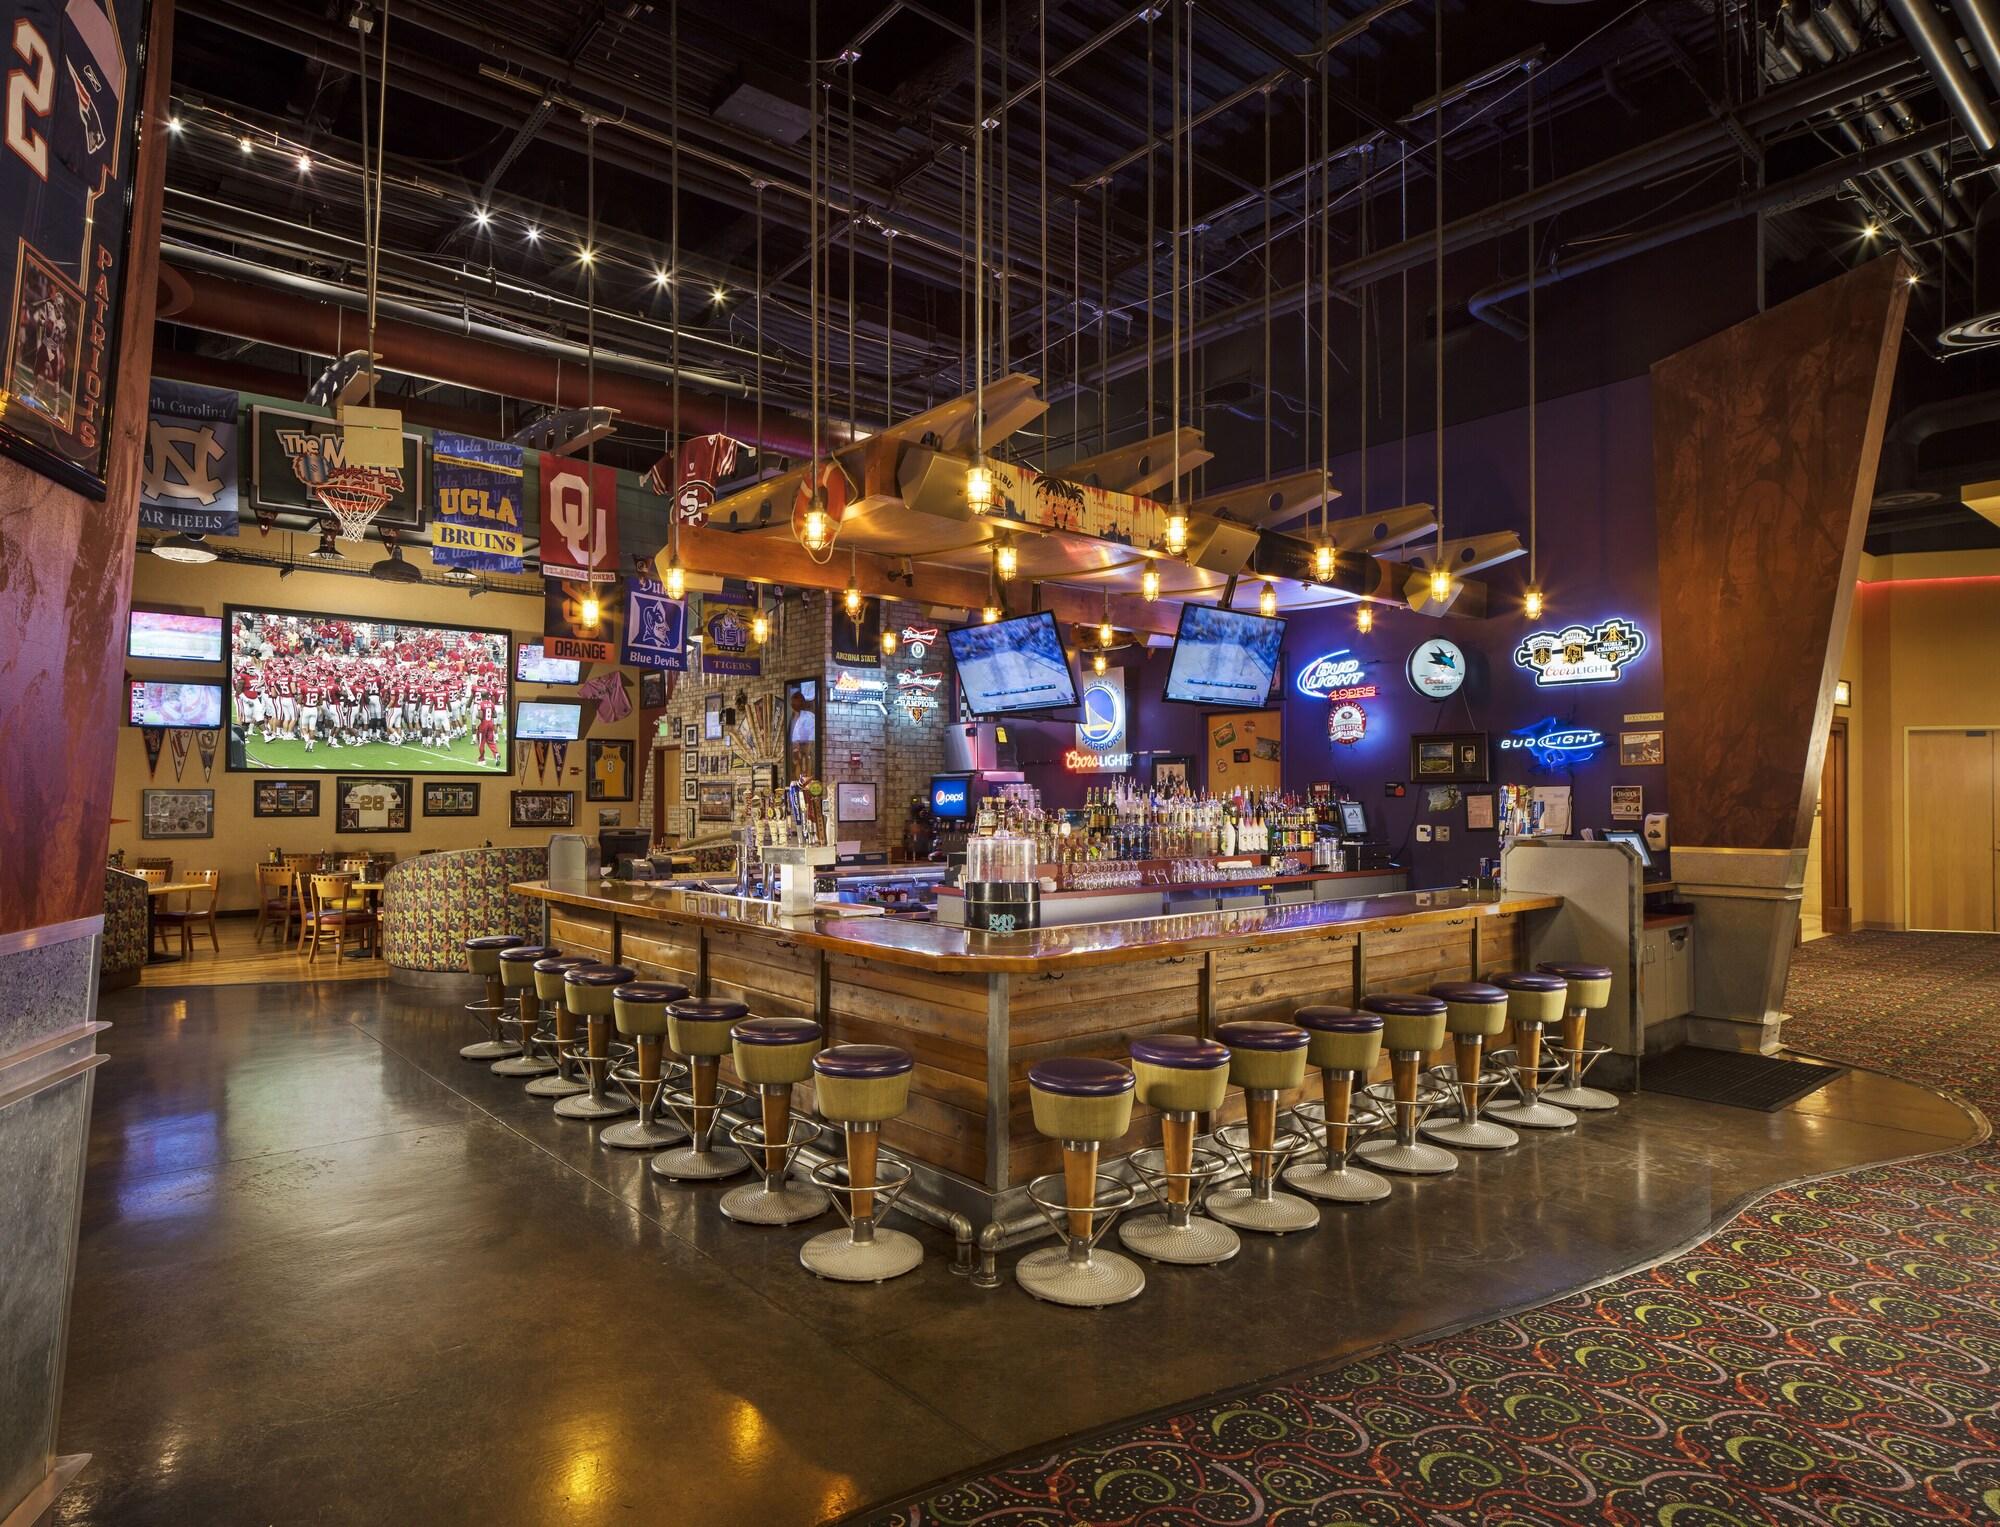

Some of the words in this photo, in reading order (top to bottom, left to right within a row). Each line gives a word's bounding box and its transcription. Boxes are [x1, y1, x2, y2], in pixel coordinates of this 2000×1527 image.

[80, 244, 114, 448] PATRIOTS
[170, 398, 227, 418] Carolina
[283, 434, 319, 455] The
[439, 488, 518, 527] UCLA
[171, 513, 223, 529] HEELS
[440, 527, 516, 552] BRUINS
[554, 640, 607, 659] ORANGE
[835, 651, 860, 662] ARIZONA
[860, 654, 878, 663] STATE
[629, 651, 651, 664] Blue
[654, 654, 680, 668] Devils
[713, 660, 752, 671] TIGERS
[1315, 660, 1359, 677] BUD
[1545, 664, 1576, 677] Coors
[1576, 664, 1609, 675] LIGHT
[1306, 672, 1365, 689] LIGHT
[1328, 686, 1376, 701] 49ERS
[894, 700, 938, 708] CHAMPIONS
[1082, 730, 1122, 751] WARRIORS
[1500, 738, 1536, 749] BUD
[1545, 732, 1601, 746] LIGHT
[1066, 751, 1098, 769] Coors
[1098, 753, 1129, 767] LIGHT
[945, 791, 964, 803] pepsi
